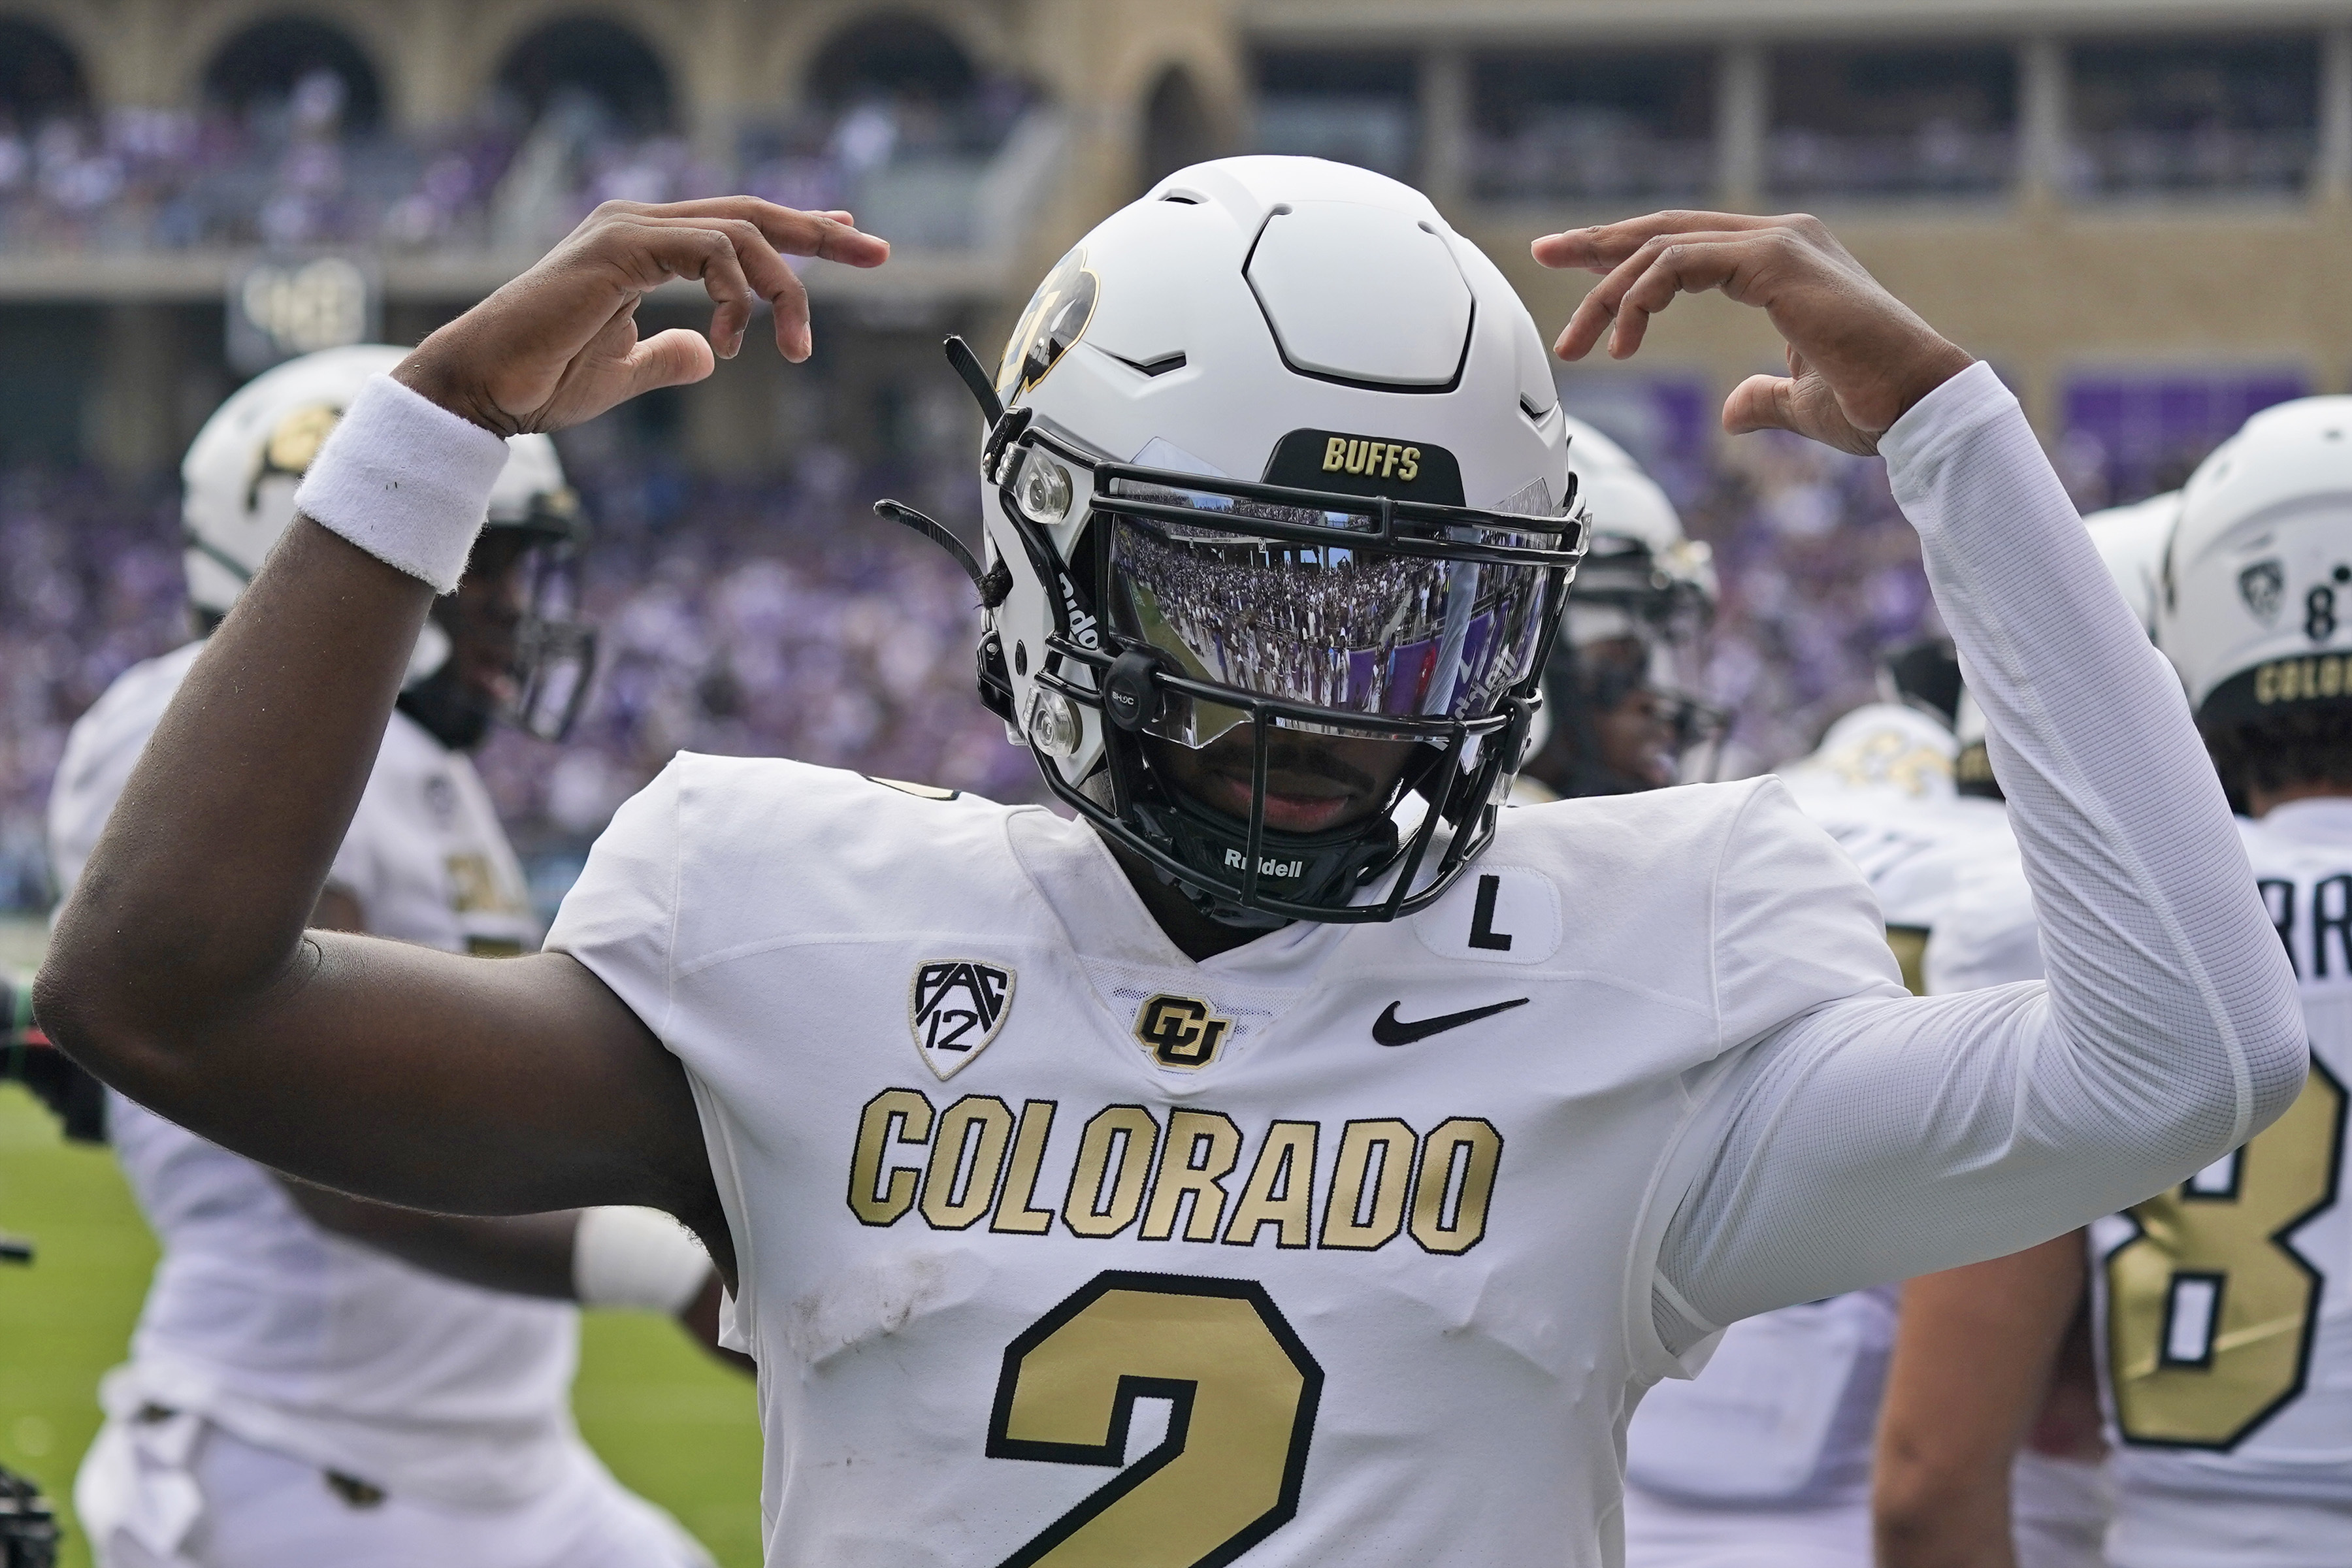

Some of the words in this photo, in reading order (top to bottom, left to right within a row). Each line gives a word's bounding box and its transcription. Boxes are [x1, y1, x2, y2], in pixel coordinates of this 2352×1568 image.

[1322, 437, 1421, 482] BUFFS
[2304, 584, 2337, 642] 8
[2255, 656, 2352, 705] COLO
[1468, 872, 1512, 951] L
[915, 963, 1007, 1034] PAC
[926, 1009, 979, 1052] 12
[1135, 993, 1233, 1071] CU
[847, 1086, 1504, 1256] COLORADO
[985, 1269, 1326, 1568] 2
